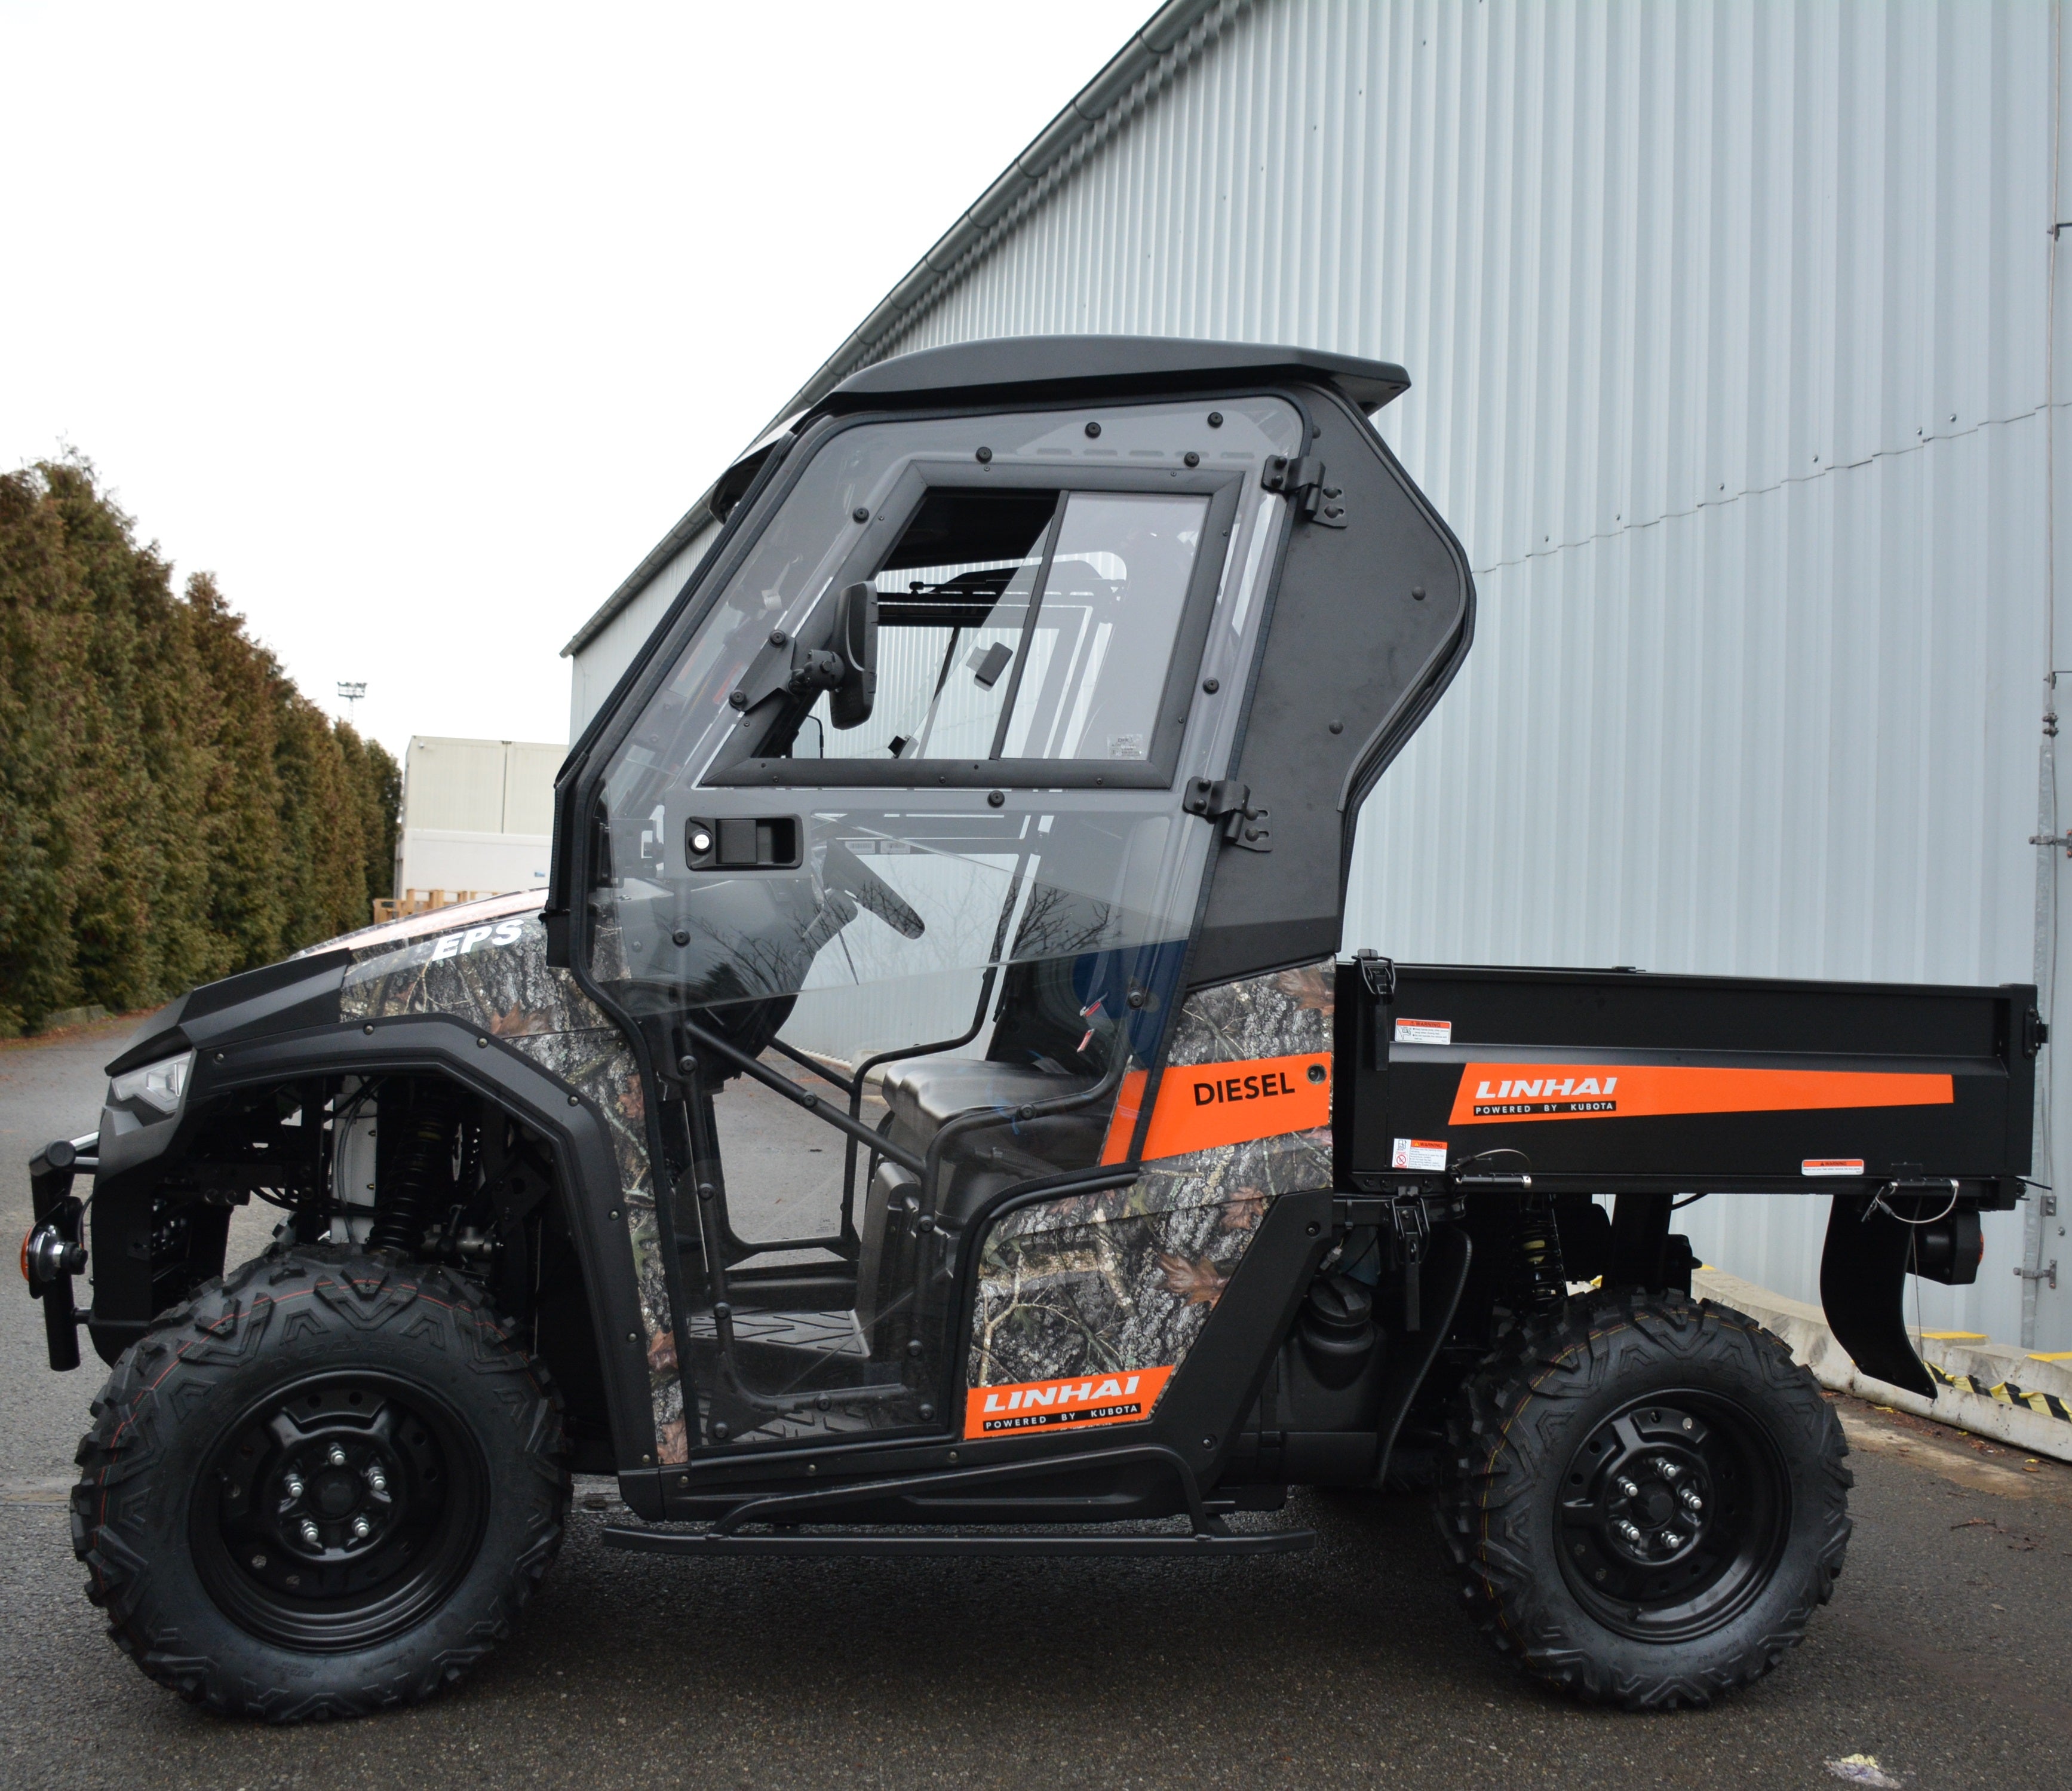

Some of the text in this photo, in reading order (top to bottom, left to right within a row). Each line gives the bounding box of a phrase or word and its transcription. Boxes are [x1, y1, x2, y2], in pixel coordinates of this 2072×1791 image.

[432, 919, 524, 961] EPS
[1193, 1072, 1296, 1106] DIESEL
[1475, 1077, 1617, 1099] LINHAI
[1476, 1105, 1531, 1114] POWERED
[1570, 1102, 1613, 1111] KUBOTA
[983, 1376, 1140, 1412] LINHAI
[986, 1404, 1137, 1429] POWERED BY KUBOTA
